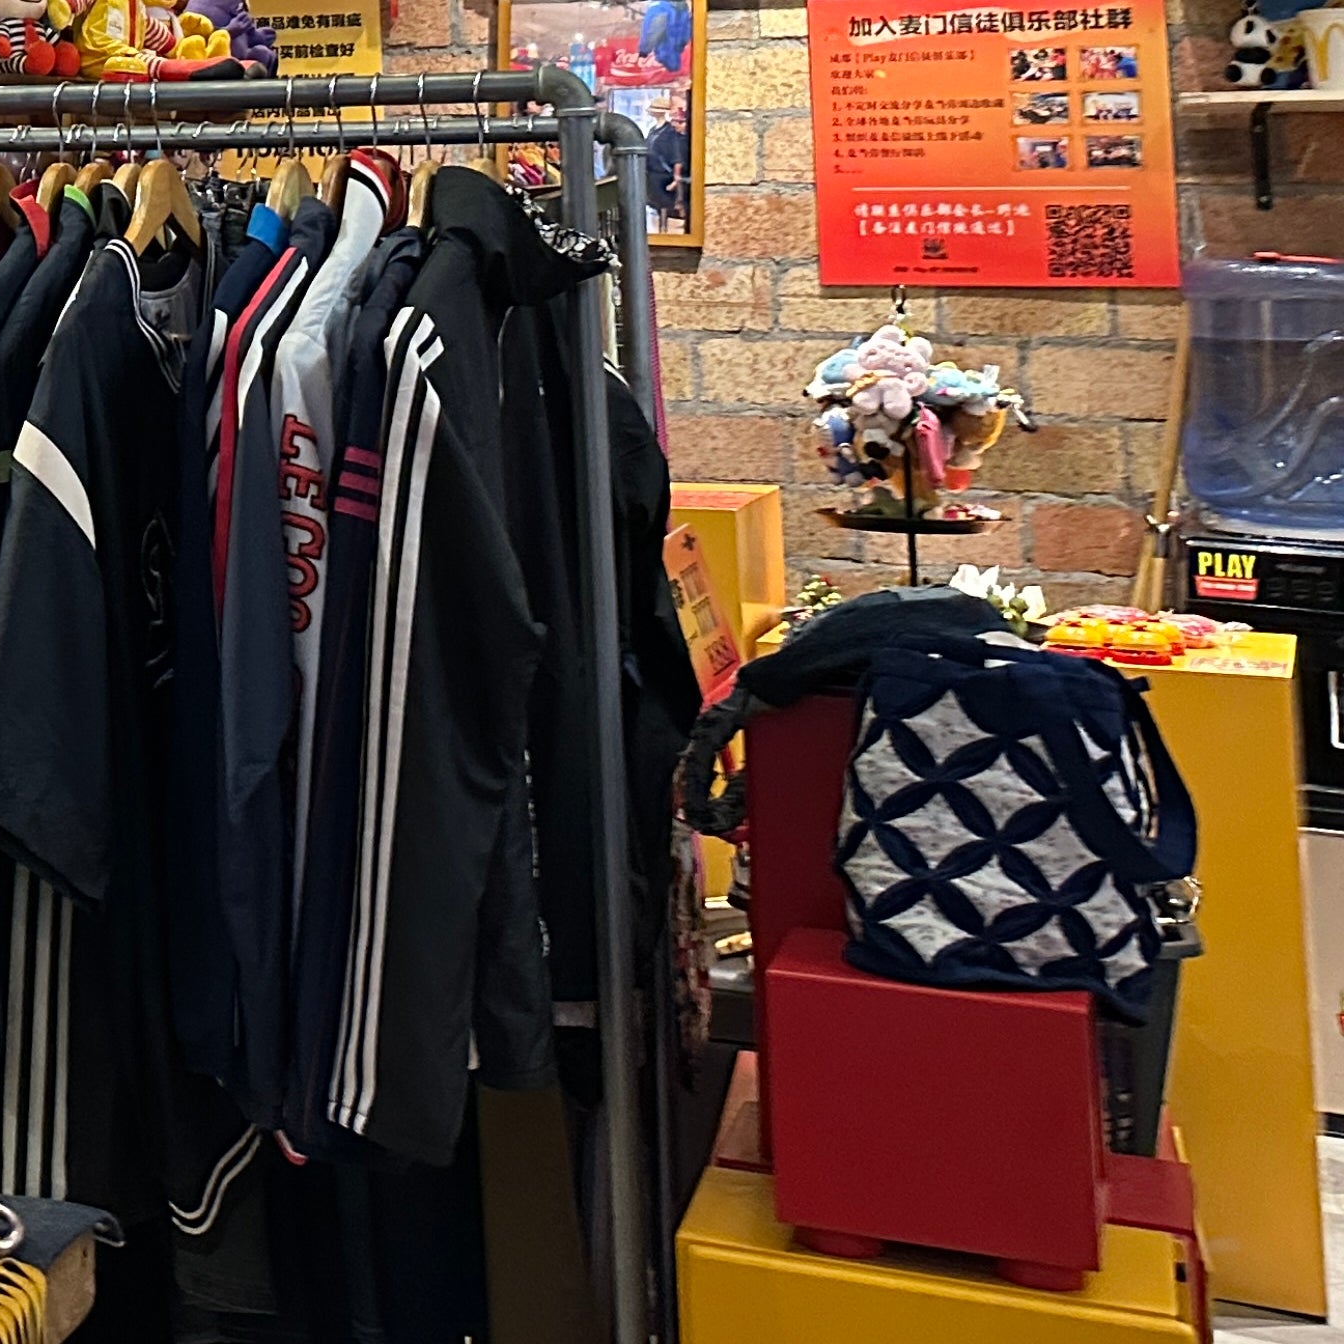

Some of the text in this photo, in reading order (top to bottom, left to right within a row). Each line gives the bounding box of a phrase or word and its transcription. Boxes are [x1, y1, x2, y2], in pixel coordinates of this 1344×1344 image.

[253, 12, 362, 30] 商品难免有瑕疵
[849, 8, 1133, 38] 加入麦门信徒俱乐部社群
[1197, 551, 1257, 580] PLAY
